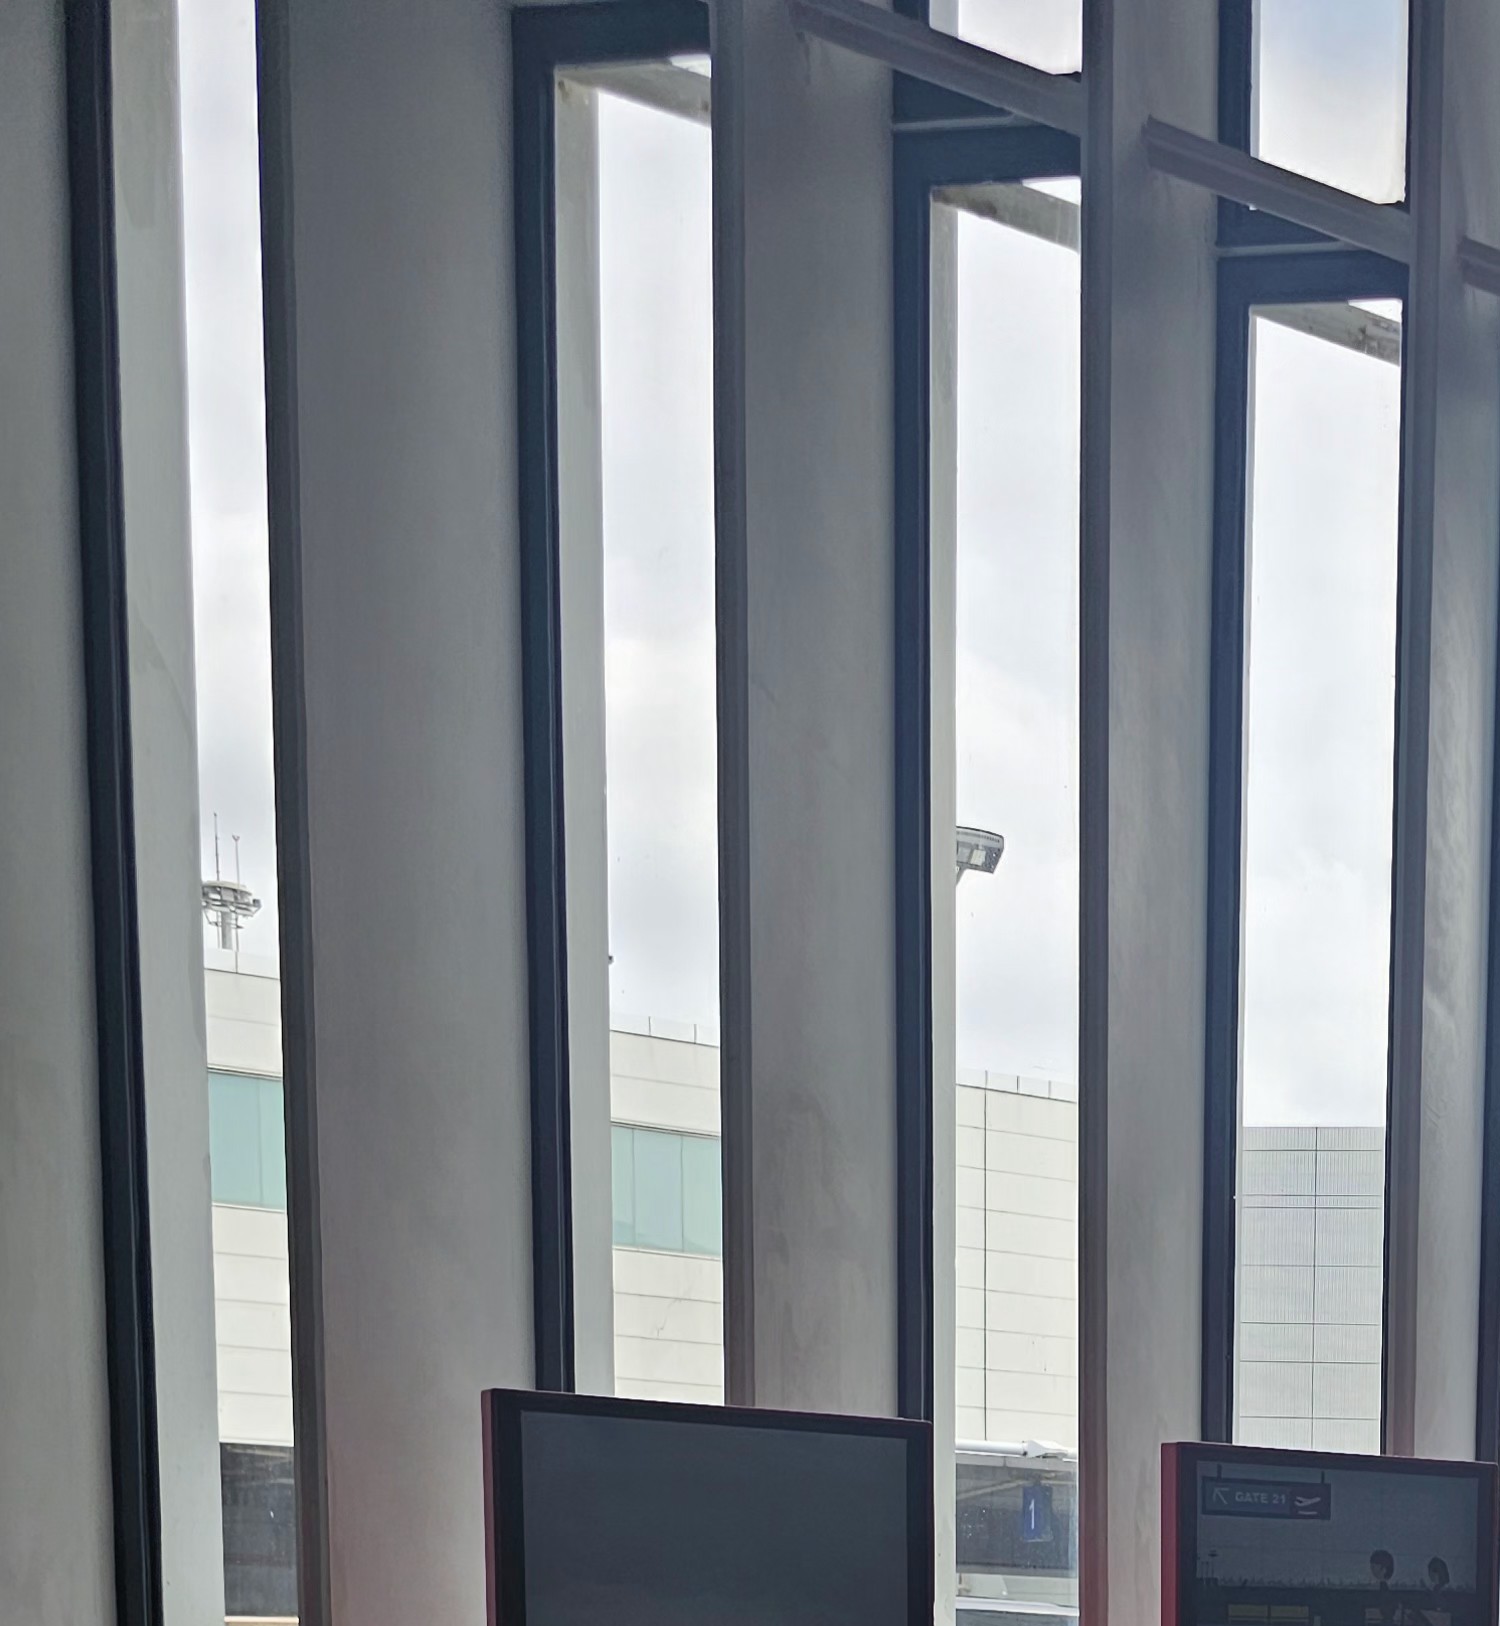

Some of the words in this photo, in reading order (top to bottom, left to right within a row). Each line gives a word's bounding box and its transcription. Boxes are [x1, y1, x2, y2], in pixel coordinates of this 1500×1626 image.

[1234, 1491, 1268, 1504] GATE
[1271, 1493, 1287, 1505] 21
[1028, 1498, 1036, 1531] 1
